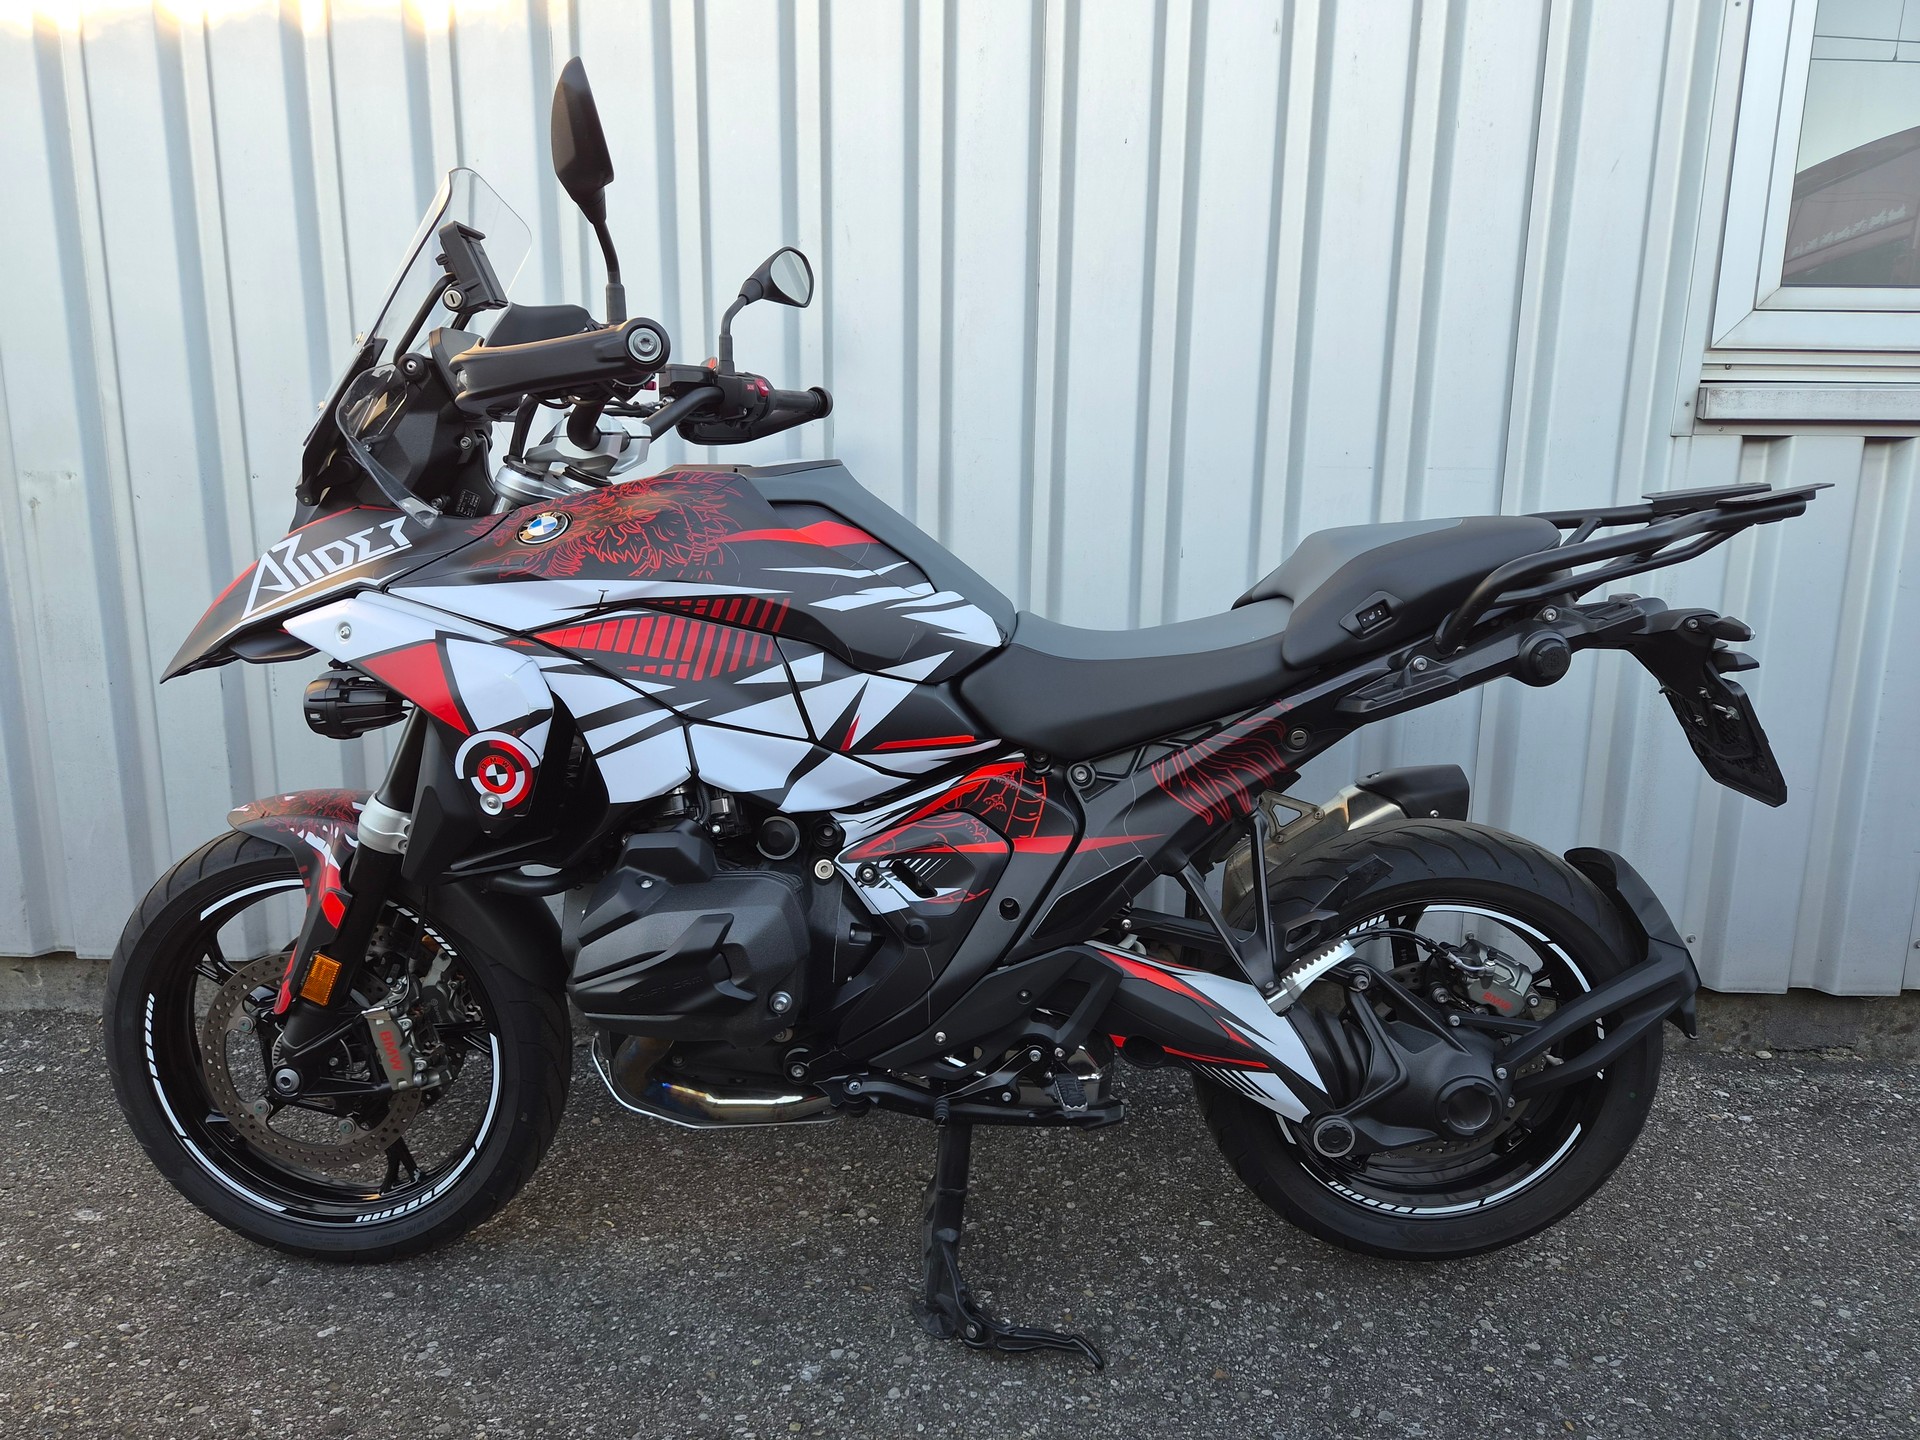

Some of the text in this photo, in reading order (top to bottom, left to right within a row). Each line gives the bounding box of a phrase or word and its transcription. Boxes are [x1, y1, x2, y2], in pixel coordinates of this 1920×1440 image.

[480, 757, 510, 770] BMW
[1482, 991, 1514, 1011] BMW
[379, 1031, 406, 1071] BMW
